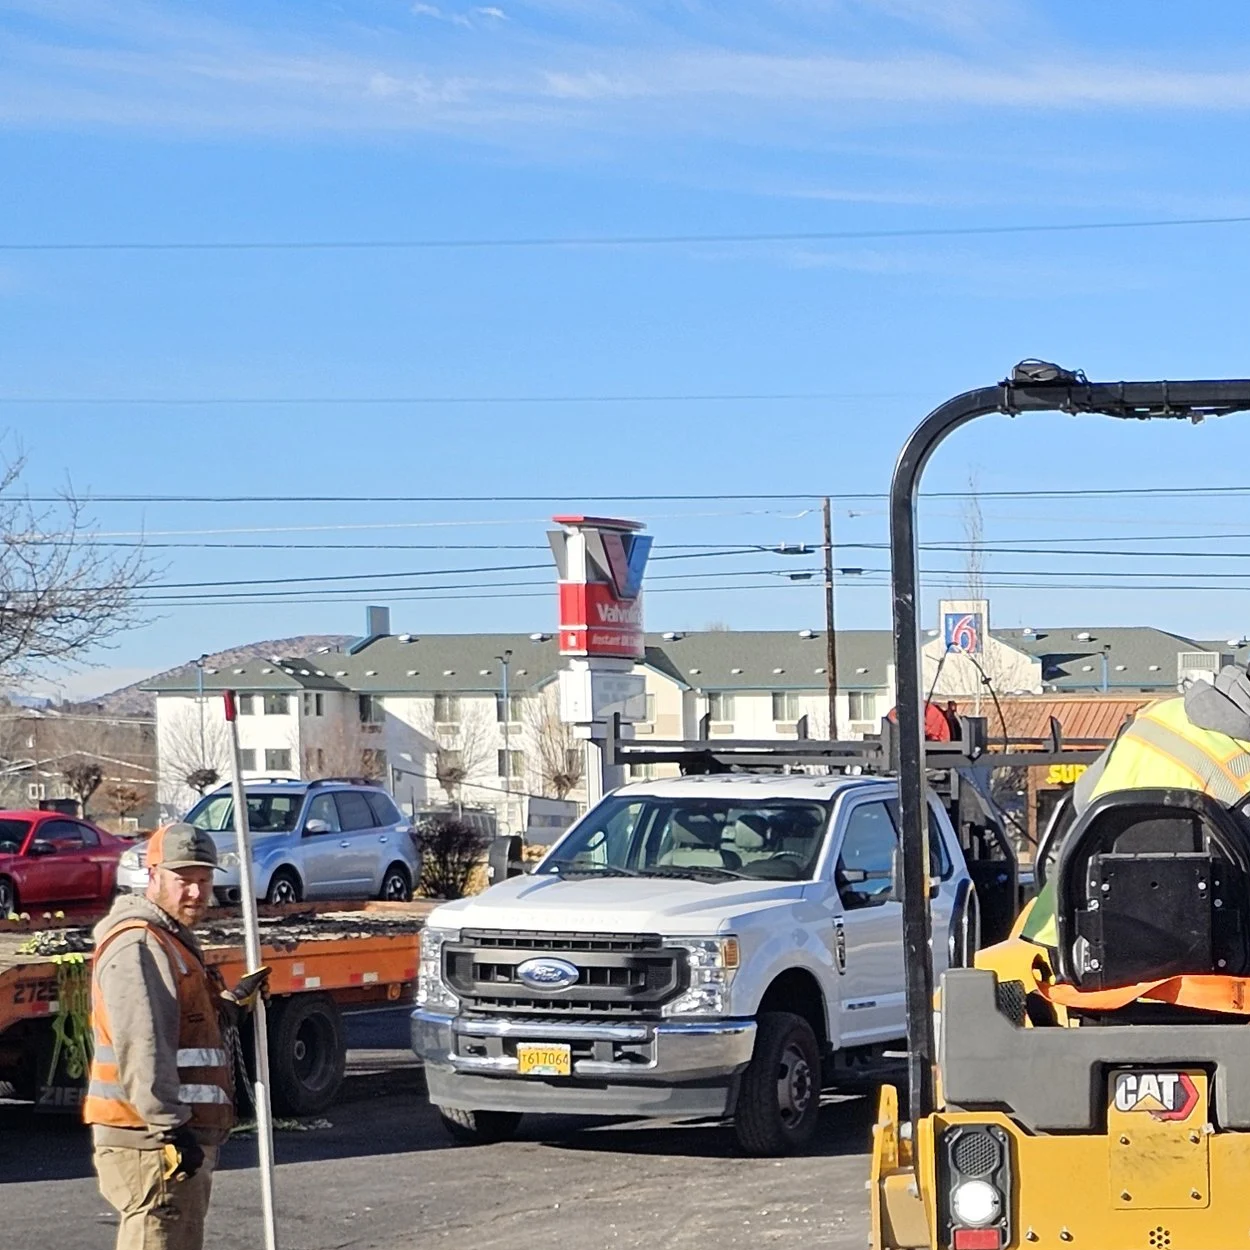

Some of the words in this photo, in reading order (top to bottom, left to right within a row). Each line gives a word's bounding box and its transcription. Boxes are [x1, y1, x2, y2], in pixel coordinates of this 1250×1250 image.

[952, 615, 977, 652] 6
[533, 966, 562, 981] Ford
[1115, 1074, 1179, 1111] CAT
